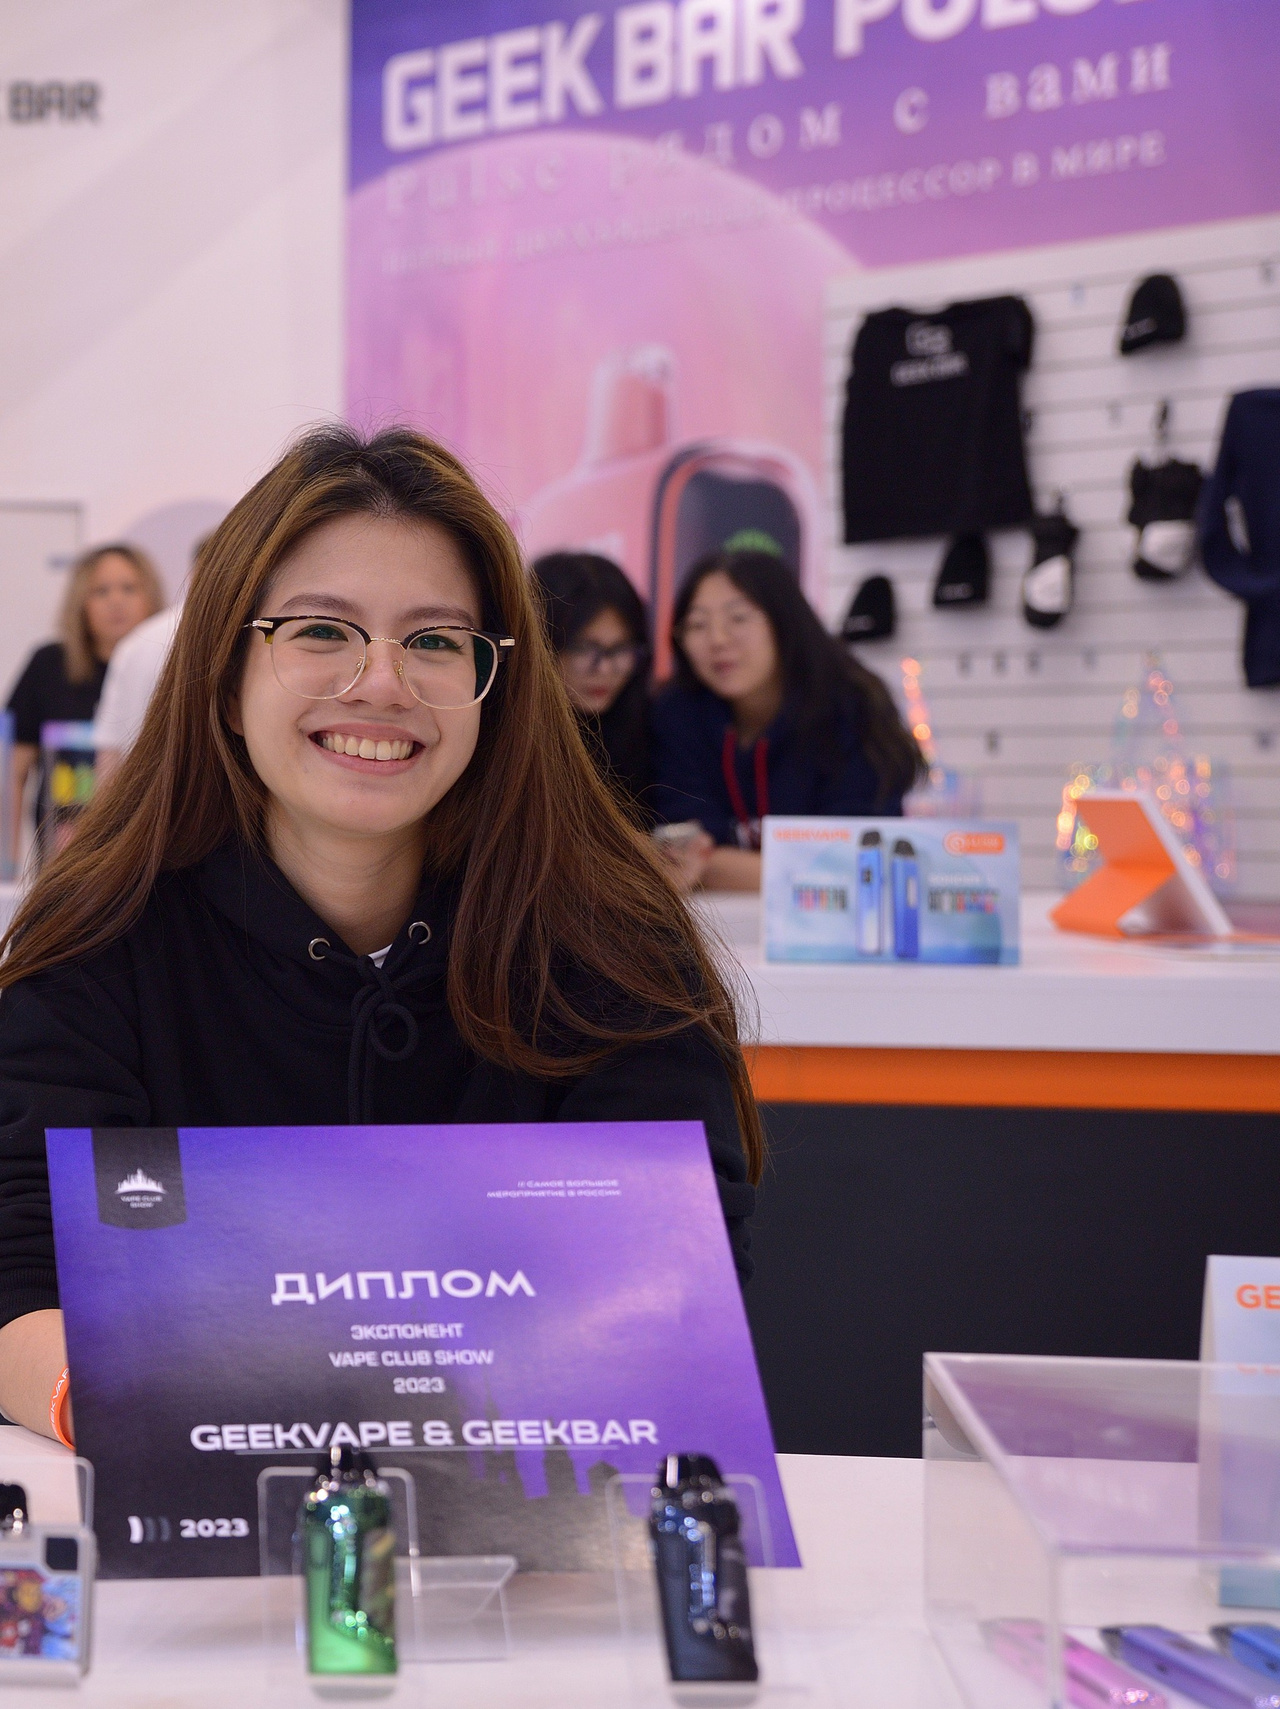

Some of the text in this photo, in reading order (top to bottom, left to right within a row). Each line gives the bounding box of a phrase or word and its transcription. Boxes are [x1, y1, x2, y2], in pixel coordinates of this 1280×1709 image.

[381, 12, 607, 152] GEEK
[613, 0, 806, 111] BAR
[8, 80, 101, 126] BAR
[270, 1269, 536, 1306] ДИПЛОМ
[350, 1322, 464, 1341] ЭКСПОНЕНТ
[328, 1348, 495, 1368] VAPE CLUB SHOW
[392, 1376, 445, 1394] 2023
[190, 1418, 659, 1451] GEEKVAPE & GEEKBAR
[180, 1517, 250, 1538] 2023
